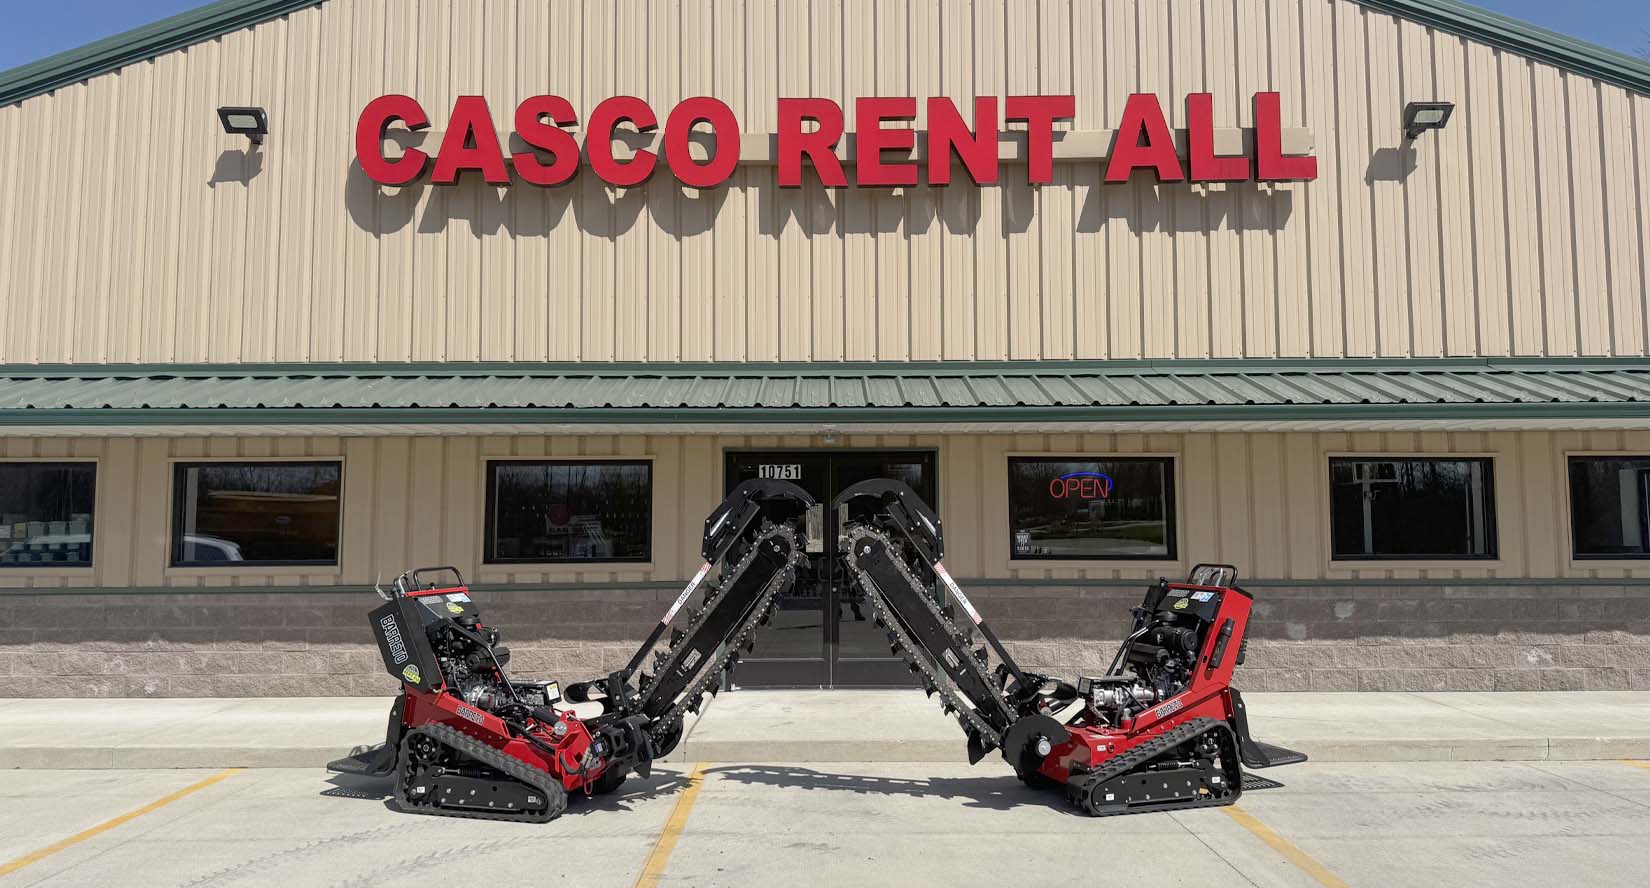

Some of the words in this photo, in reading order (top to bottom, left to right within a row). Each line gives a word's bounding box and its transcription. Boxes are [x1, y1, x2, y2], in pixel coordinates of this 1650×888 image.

[355, 94, 741, 187] CASCO
[777, 95, 1076, 188] RENT
[1104, 91, 1318, 184] ALL
[760, 465, 799, 479] 10751
[1049, 478, 1109, 498] OPEN
[677, 582, 696, 605] DANGER
[950, 582, 967, 605] DANGER
[380, 613, 408, 665] BARRETO
[456, 704, 485, 726] BARRETO
